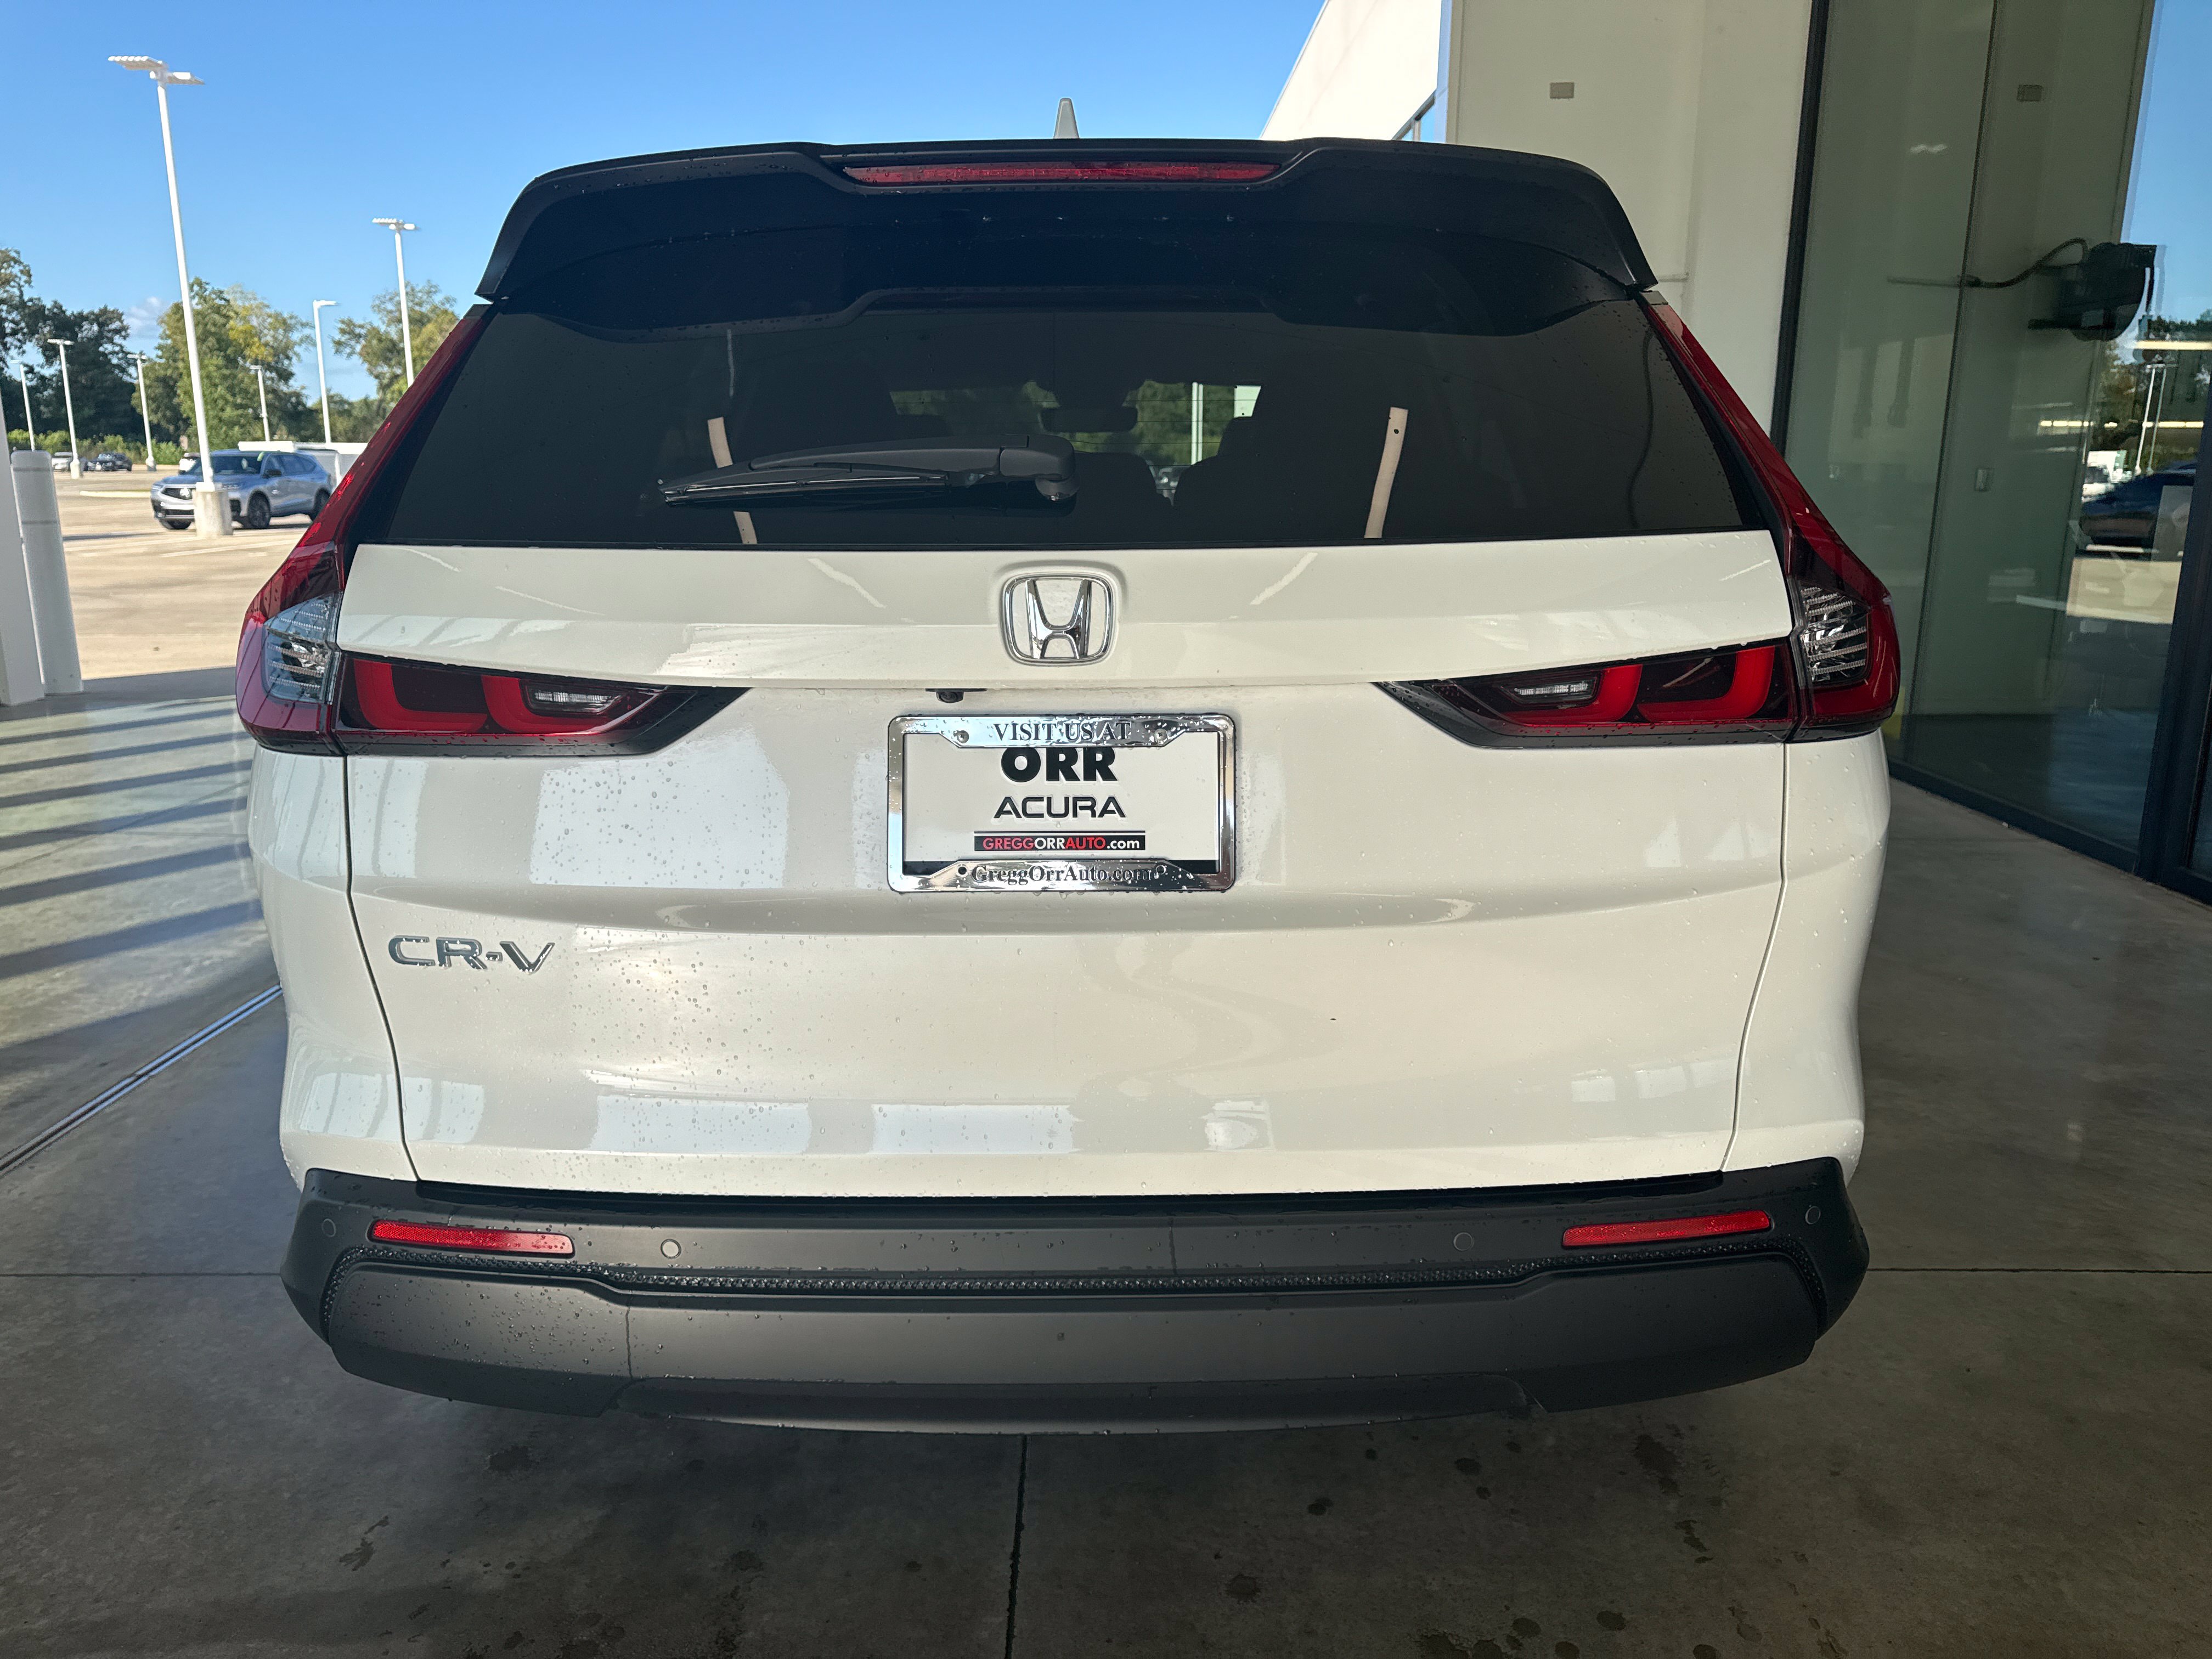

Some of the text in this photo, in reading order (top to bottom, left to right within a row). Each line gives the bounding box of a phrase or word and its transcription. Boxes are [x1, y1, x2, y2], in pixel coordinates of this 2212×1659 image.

[992, 721, 1131, 741] VISIT US AT
[1001, 747, 1117, 782] ORR
[993, 796, 1126, 819] ACURA
[983, 837, 1140, 850] GREGGORRAUTO.com
[972, 865, 1152, 885] GreggOrrAuto.com
[388, 935, 555, 974] CR-V
